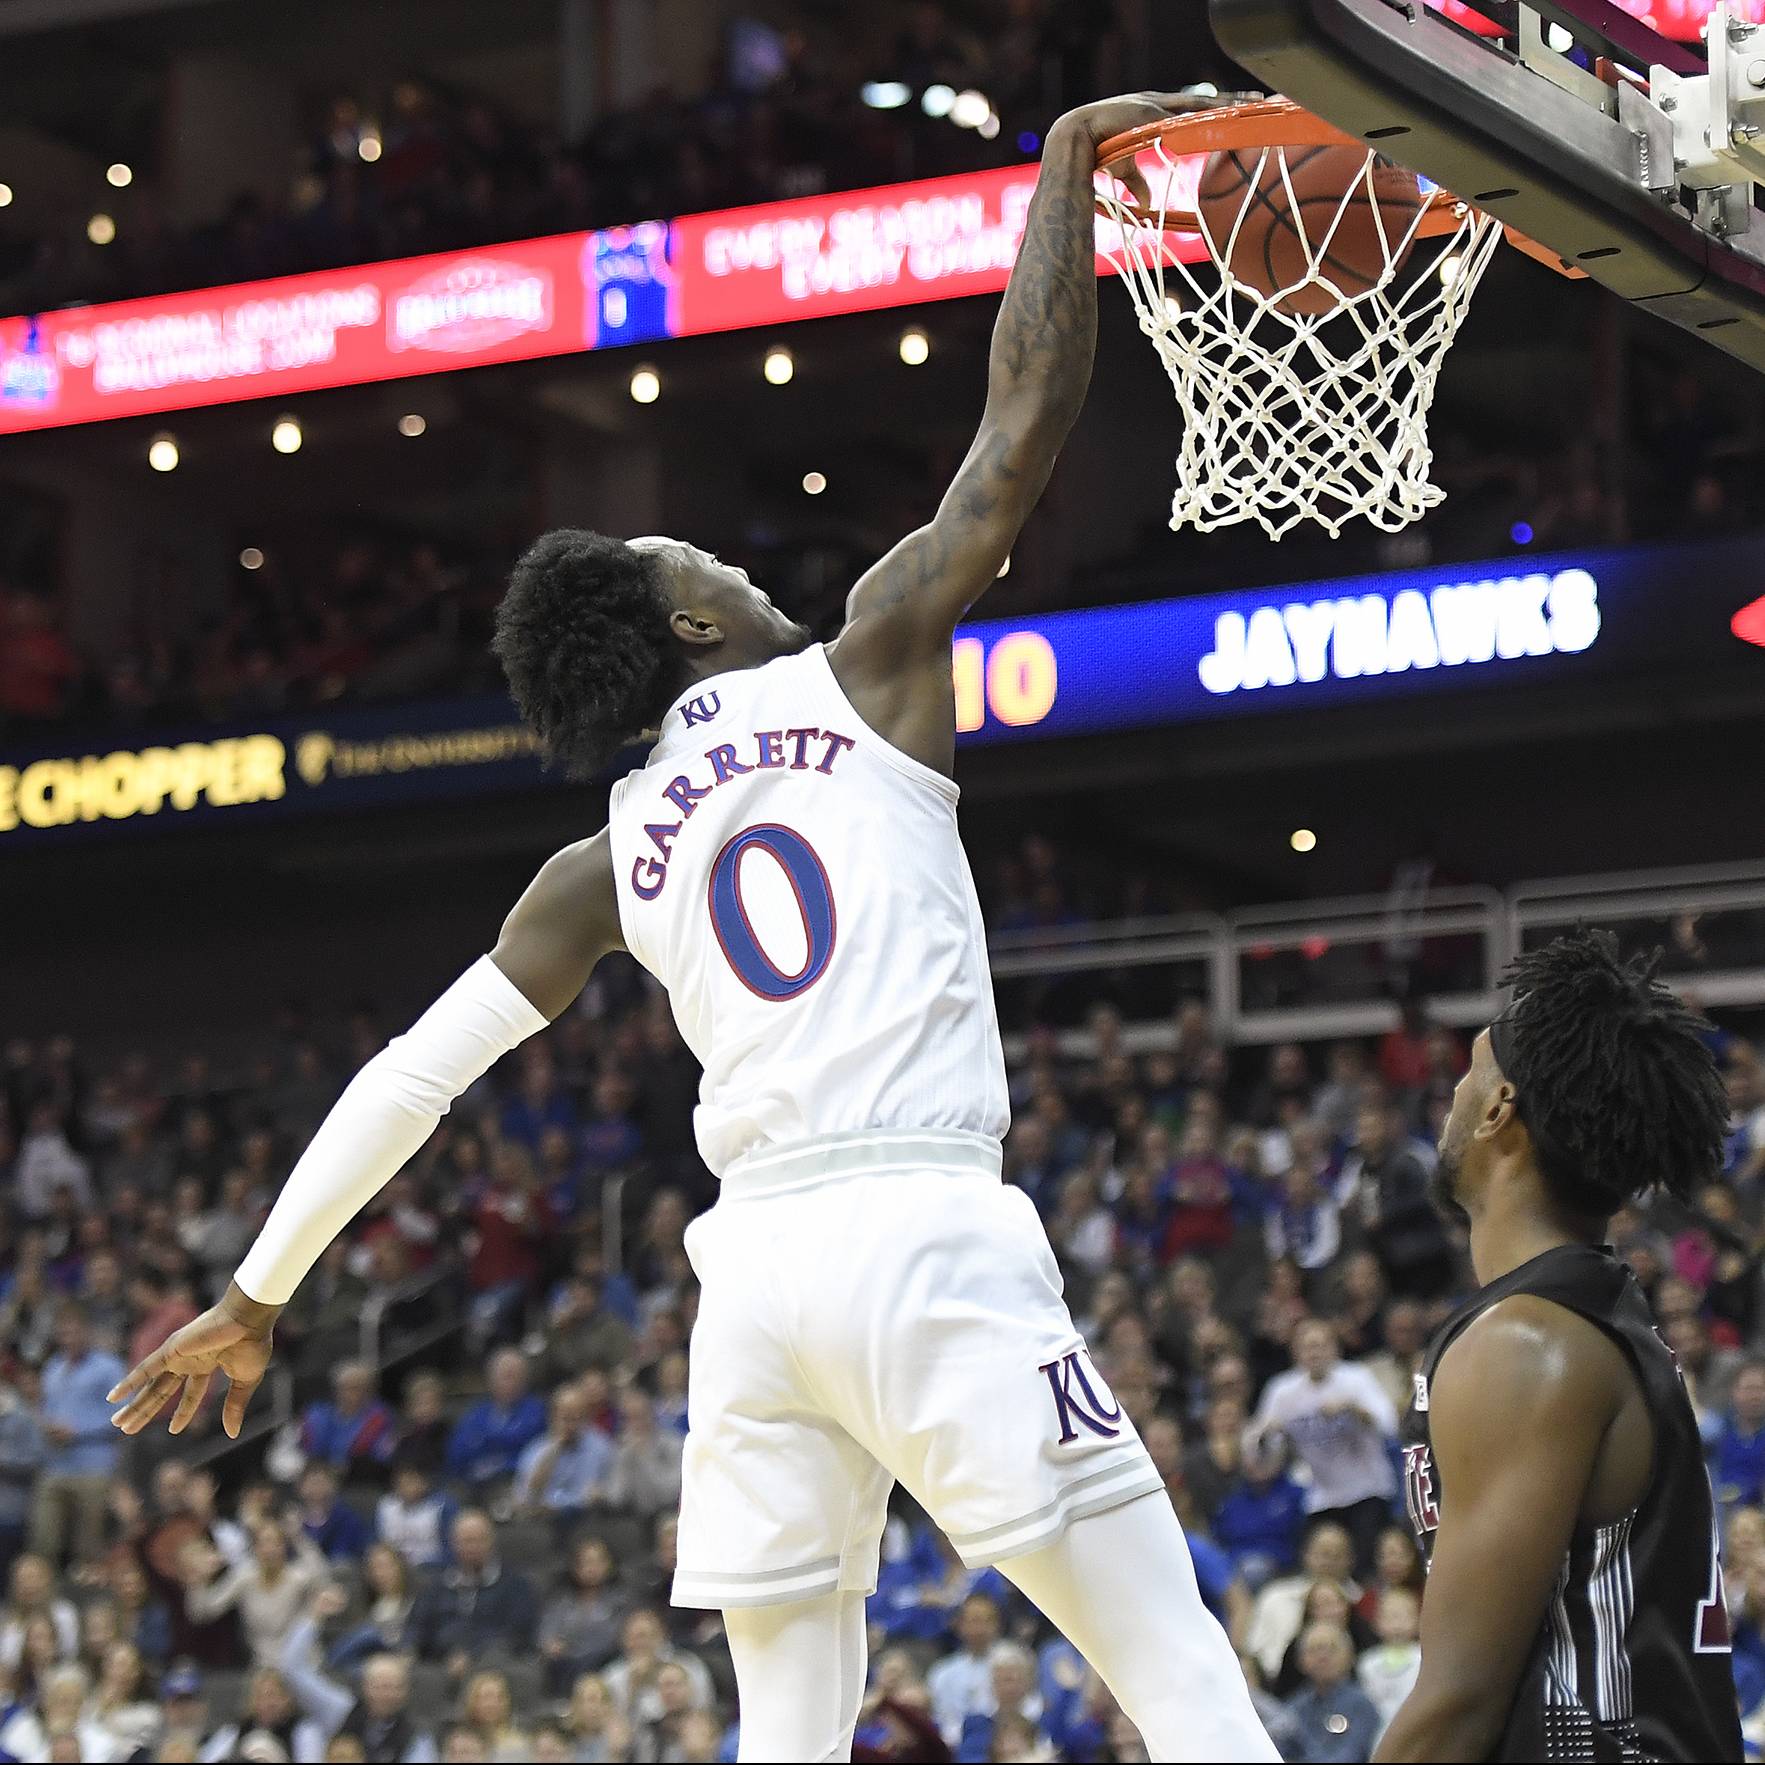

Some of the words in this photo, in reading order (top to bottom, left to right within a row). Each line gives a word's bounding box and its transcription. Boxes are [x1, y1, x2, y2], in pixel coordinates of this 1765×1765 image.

[1198, 568, 1600, 695] JAYHAWKS
[677, 689, 722, 730] KU
[17, 733, 286, 829] CHOPPER
[631, 727, 856, 901] GARRETT
[708, 822, 837, 1003] 0
[1038, 1349, 1122, 1446] KU
